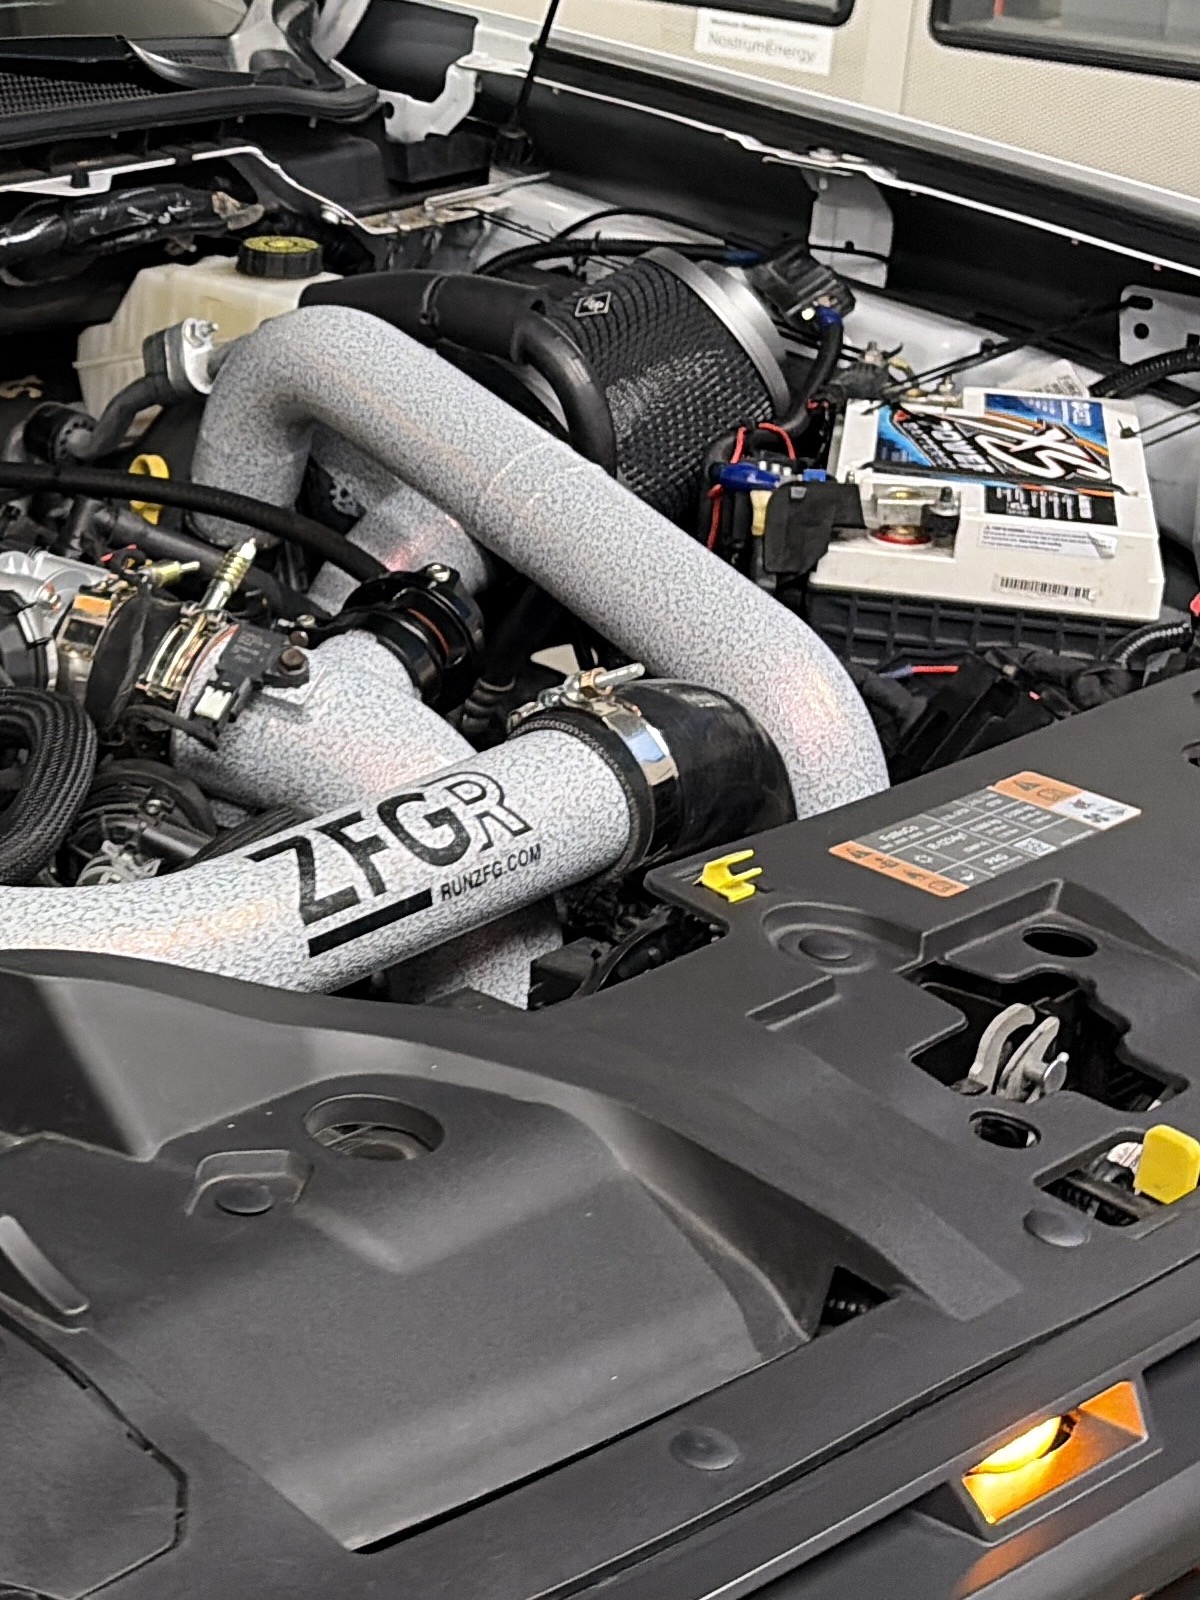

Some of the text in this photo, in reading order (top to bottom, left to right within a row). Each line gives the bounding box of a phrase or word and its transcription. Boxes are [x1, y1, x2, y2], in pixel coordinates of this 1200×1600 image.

[942, 416, 1111, 480] XS
[245, 770, 533, 926] ZFGR
[439, 843, 543, 902] RUNZFG.COM
